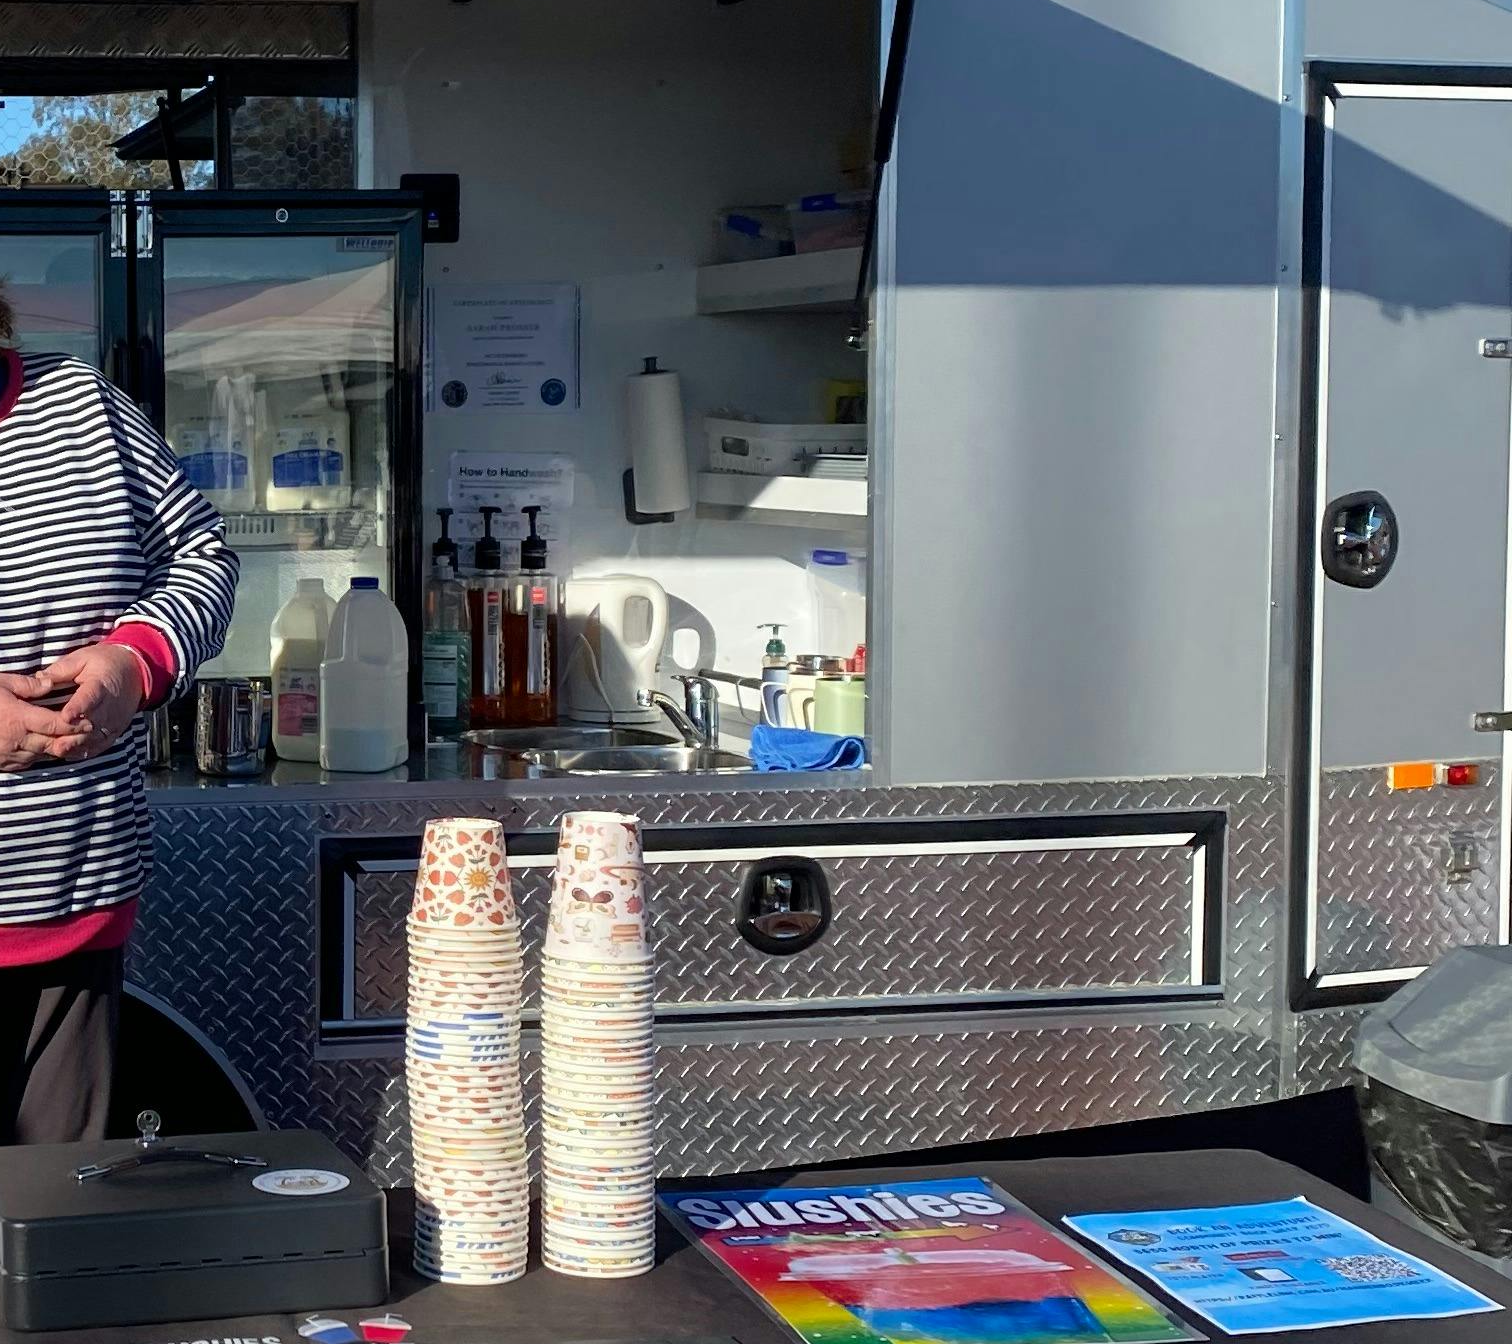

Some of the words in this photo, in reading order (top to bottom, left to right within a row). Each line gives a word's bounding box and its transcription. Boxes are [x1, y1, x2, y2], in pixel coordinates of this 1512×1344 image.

[459, 466, 483, 477] How
[487, 467, 498, 477] to
[678, 1191, 1006, 1230] Slushies
[1240, 1237, 1291, 1247] PRIZES
